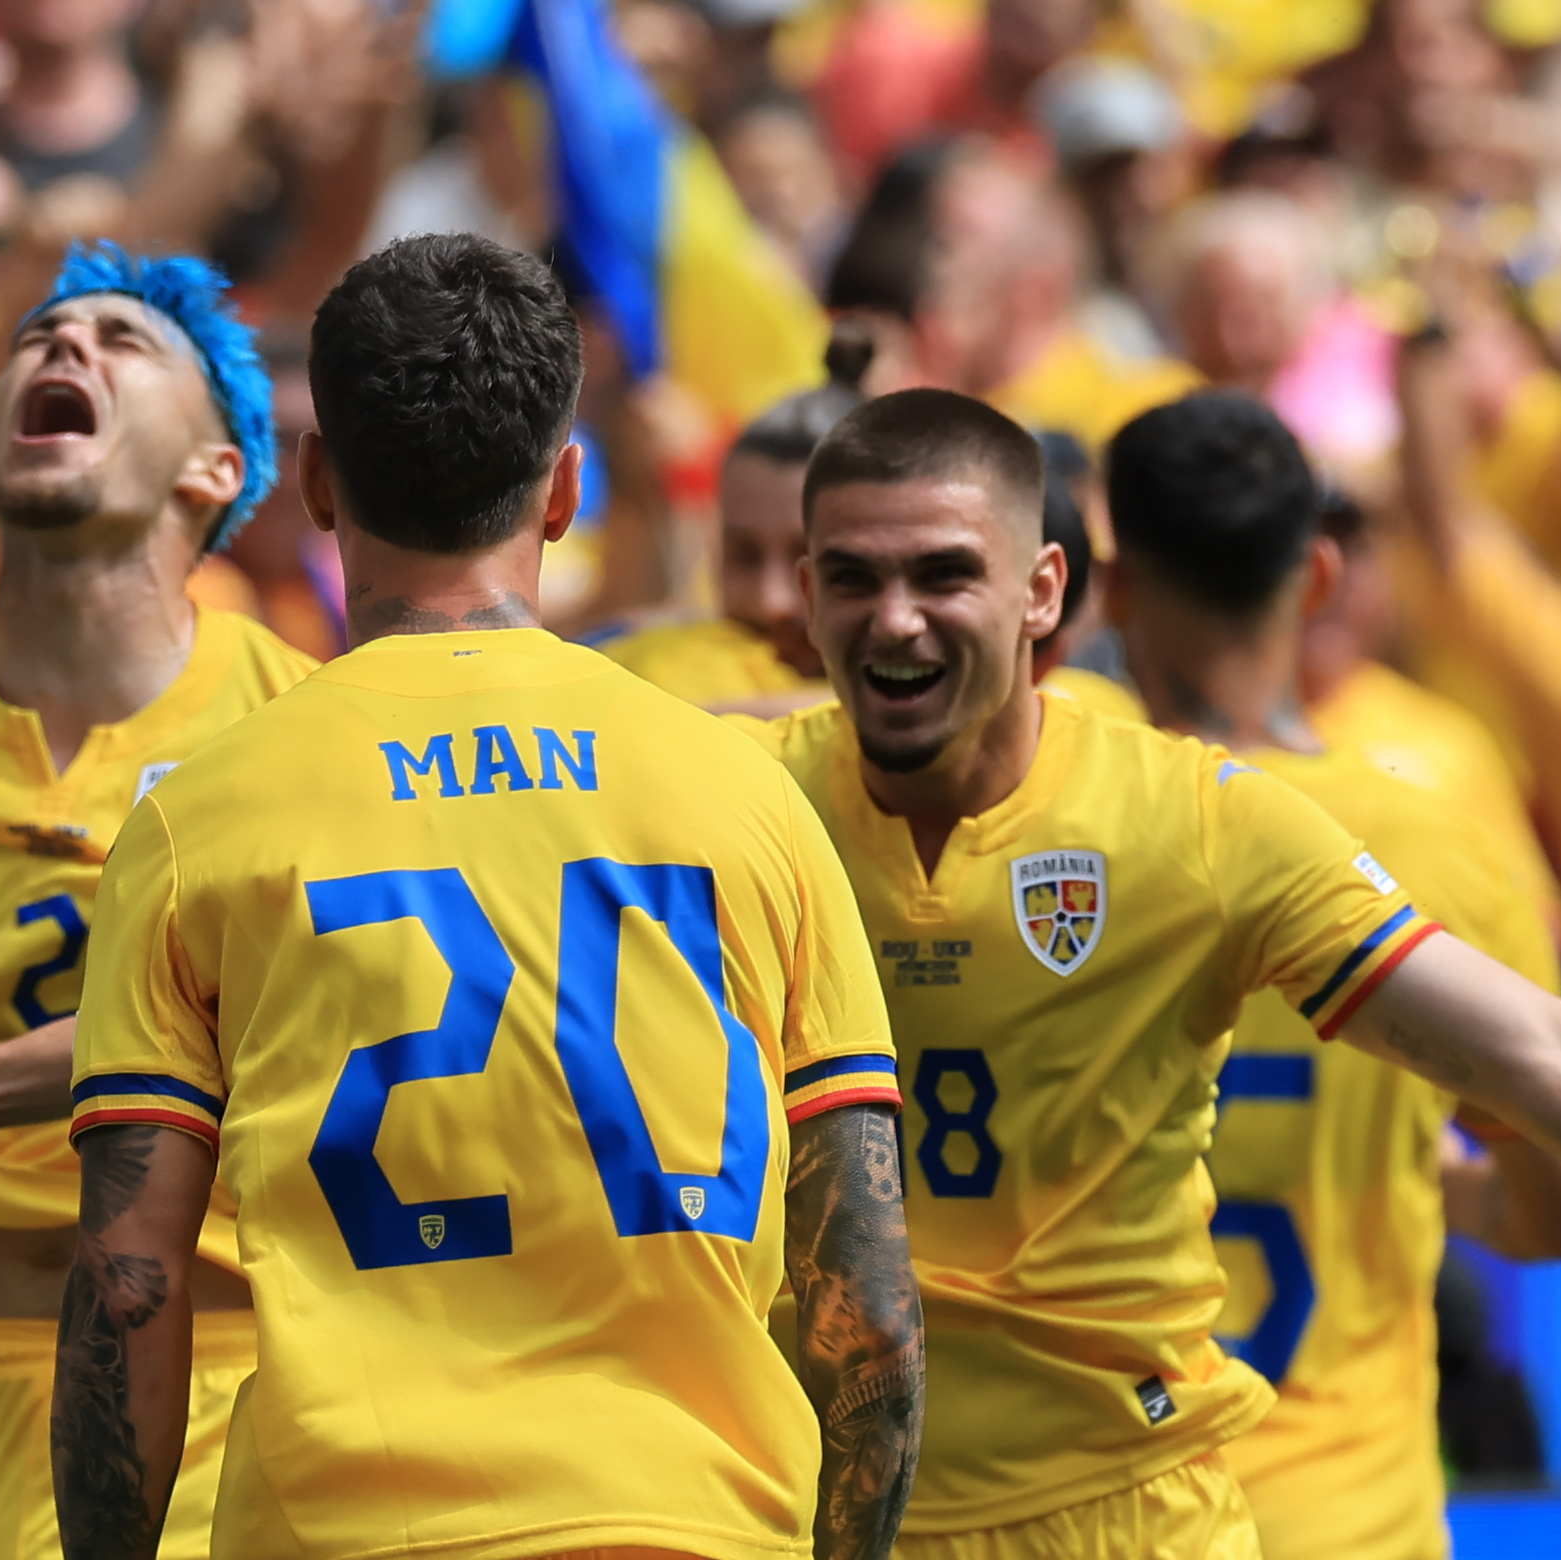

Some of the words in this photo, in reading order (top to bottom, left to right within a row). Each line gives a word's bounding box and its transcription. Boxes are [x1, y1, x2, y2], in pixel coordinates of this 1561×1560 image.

[378, 725, 598, 800] MAN
[304, 856, 771, 1271] 20
[895, 1047, 1003, 1198] 8
